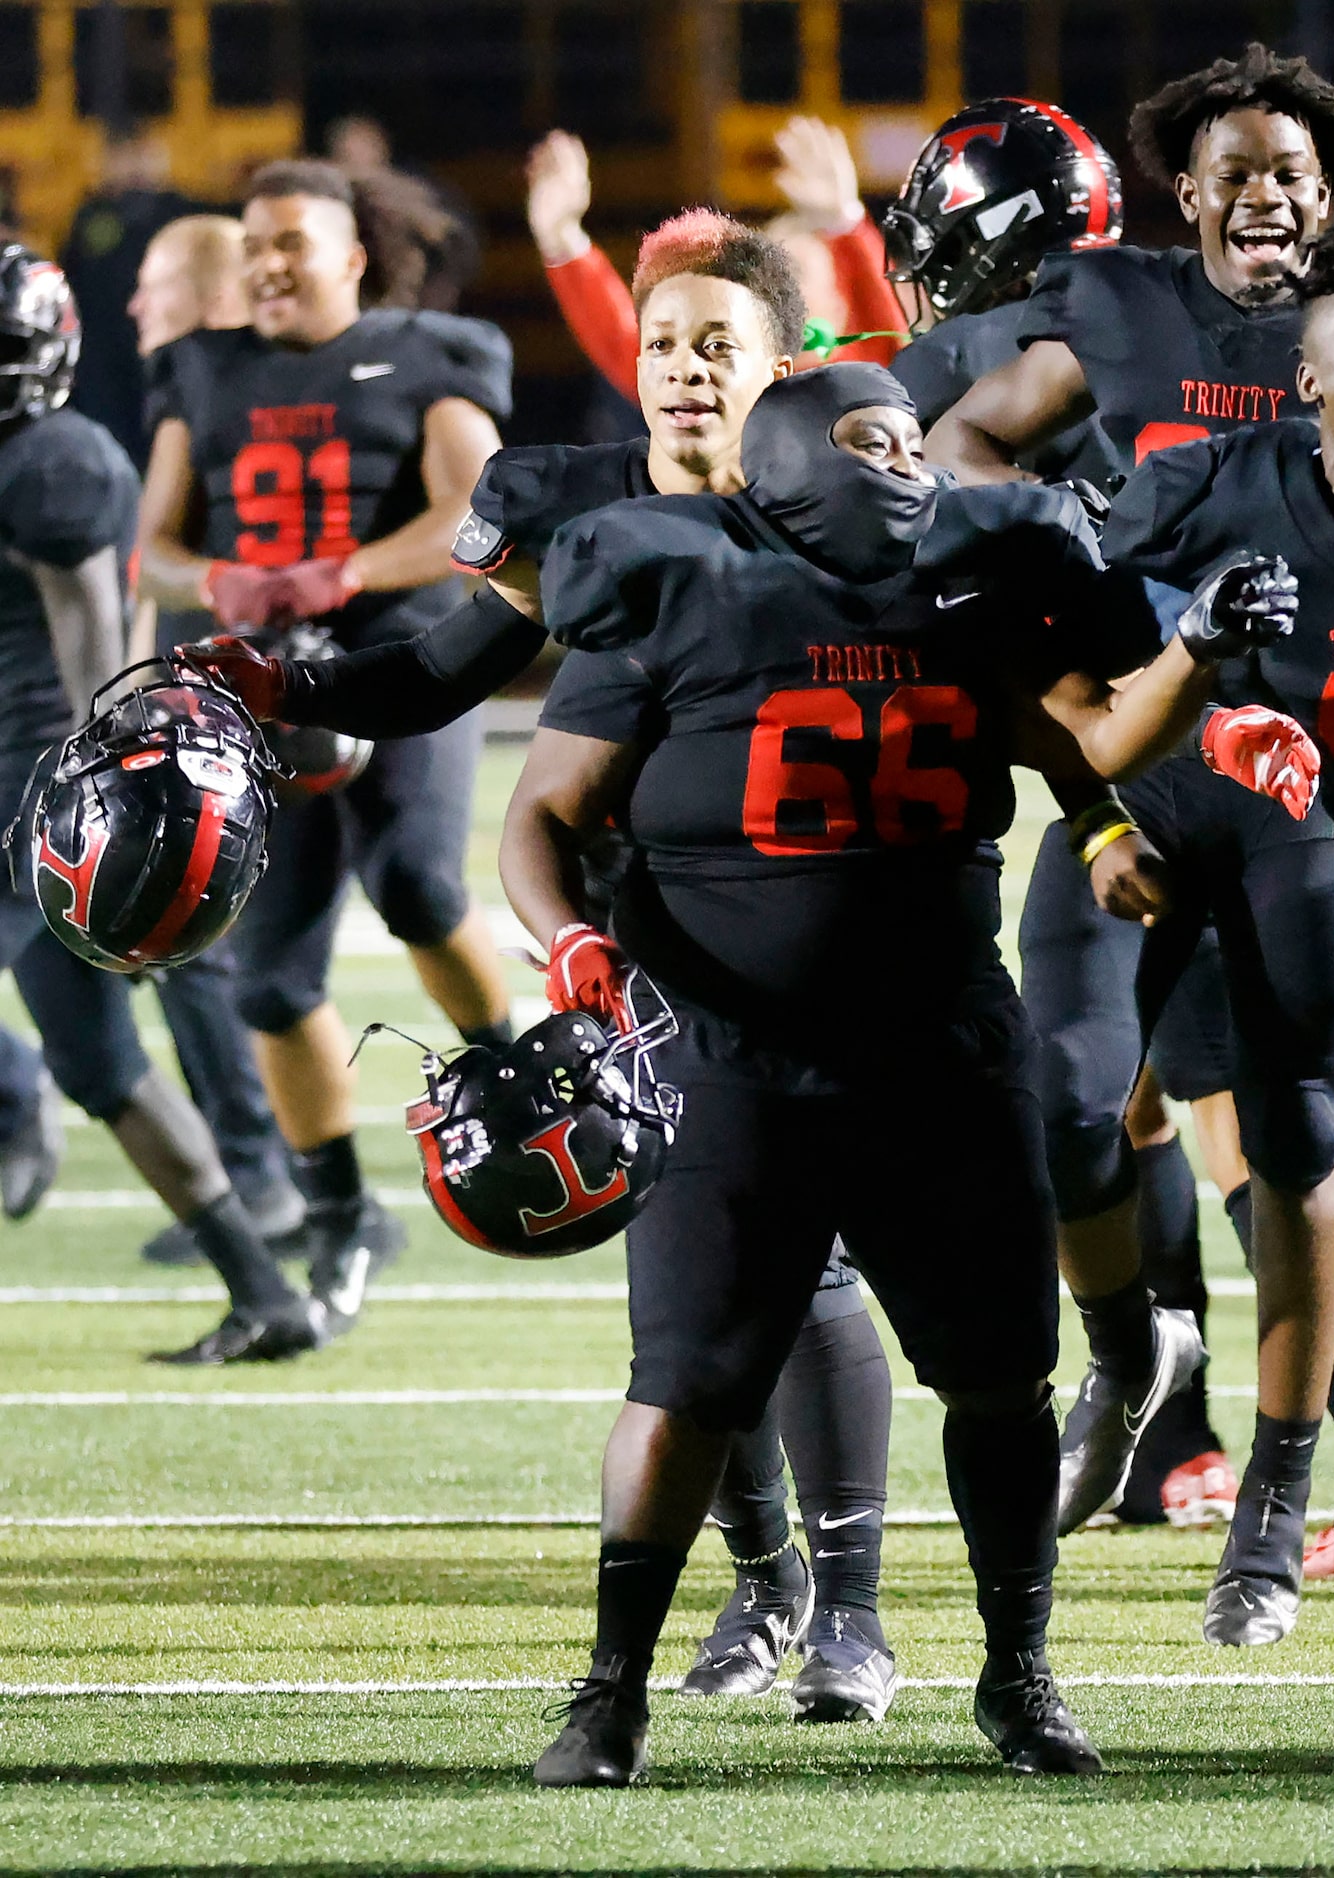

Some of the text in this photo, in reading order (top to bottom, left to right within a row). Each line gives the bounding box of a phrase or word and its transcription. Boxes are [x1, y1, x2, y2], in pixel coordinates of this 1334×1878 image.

[1180, 378, 1286, 422] TRINITY
[231, 438, 359, 566] 91
[806, 644, 922, 682] TRINITY
[742, 685, 979, 857] 66
[518, 1115, 630, 1237] T
